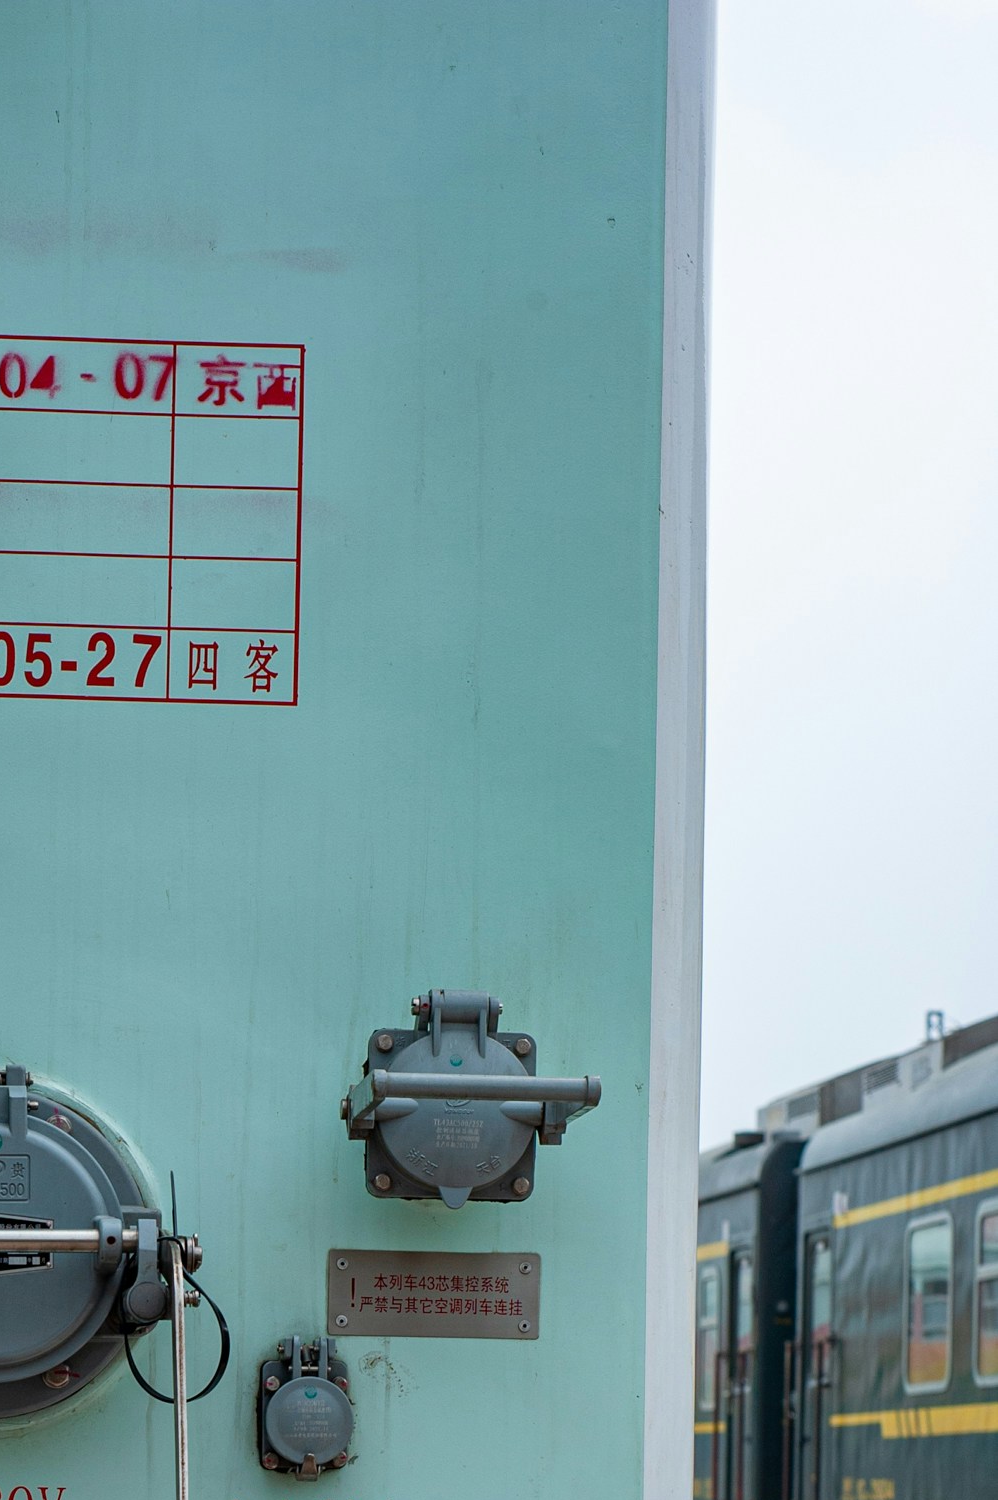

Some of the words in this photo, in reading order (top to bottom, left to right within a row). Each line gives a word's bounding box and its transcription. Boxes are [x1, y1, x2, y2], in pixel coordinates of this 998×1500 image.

[374, 1273, 510, 1294] 本列车43芯集控系统
[359, 1296, 523, 1316] 严禁与其它空调列车连挂
